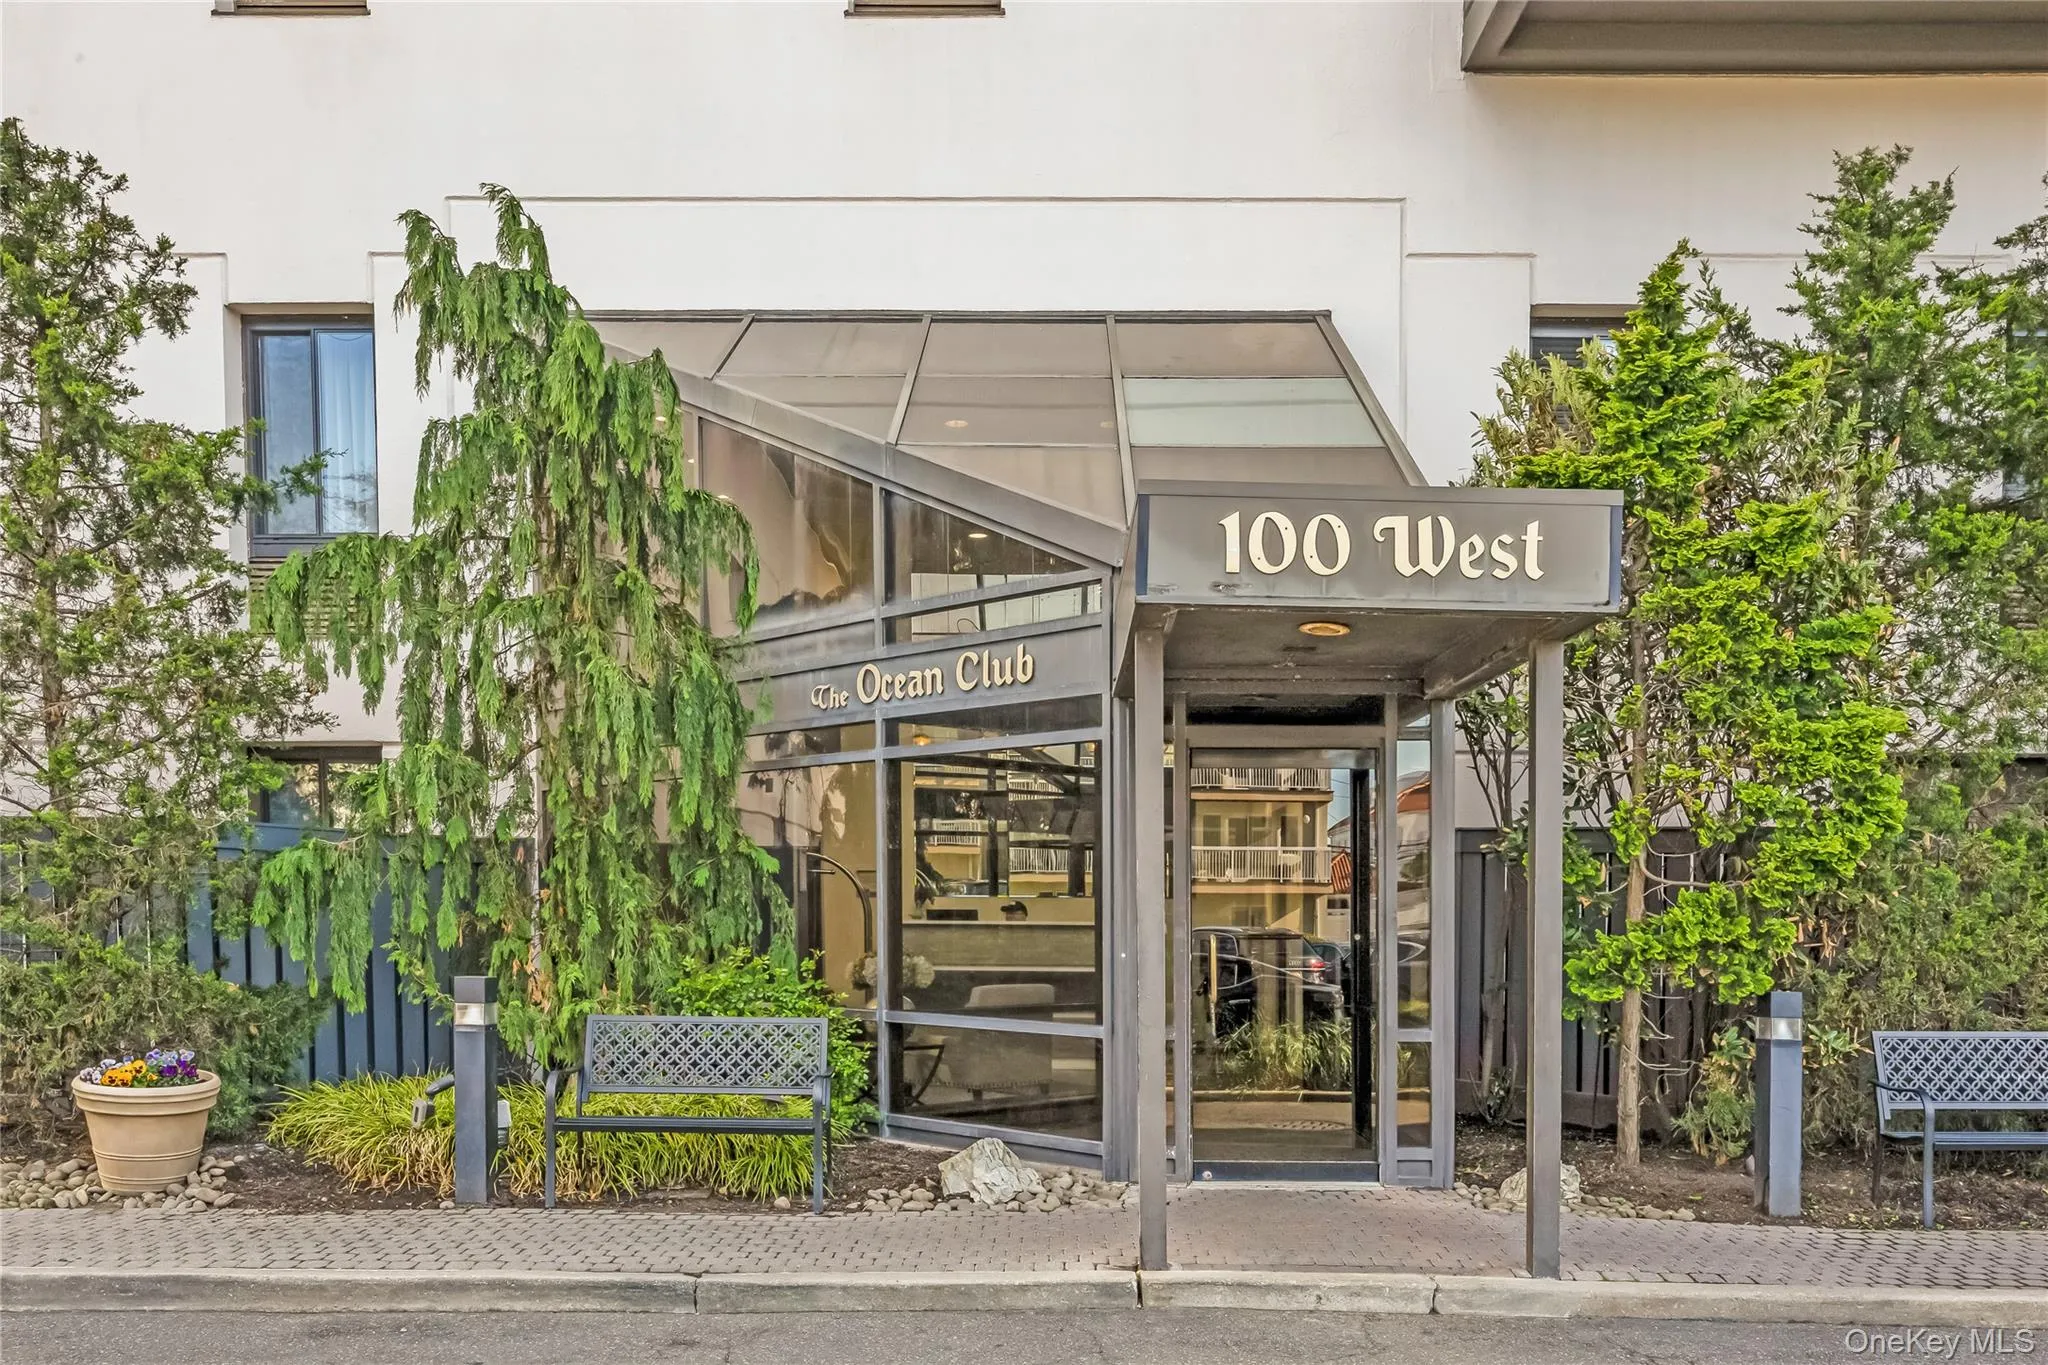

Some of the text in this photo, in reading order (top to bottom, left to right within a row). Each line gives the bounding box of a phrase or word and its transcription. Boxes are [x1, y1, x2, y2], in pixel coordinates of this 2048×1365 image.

[1218, 511, 1545, 581] 100 West
[811, 643, 1035, 710] The Ocean Club
